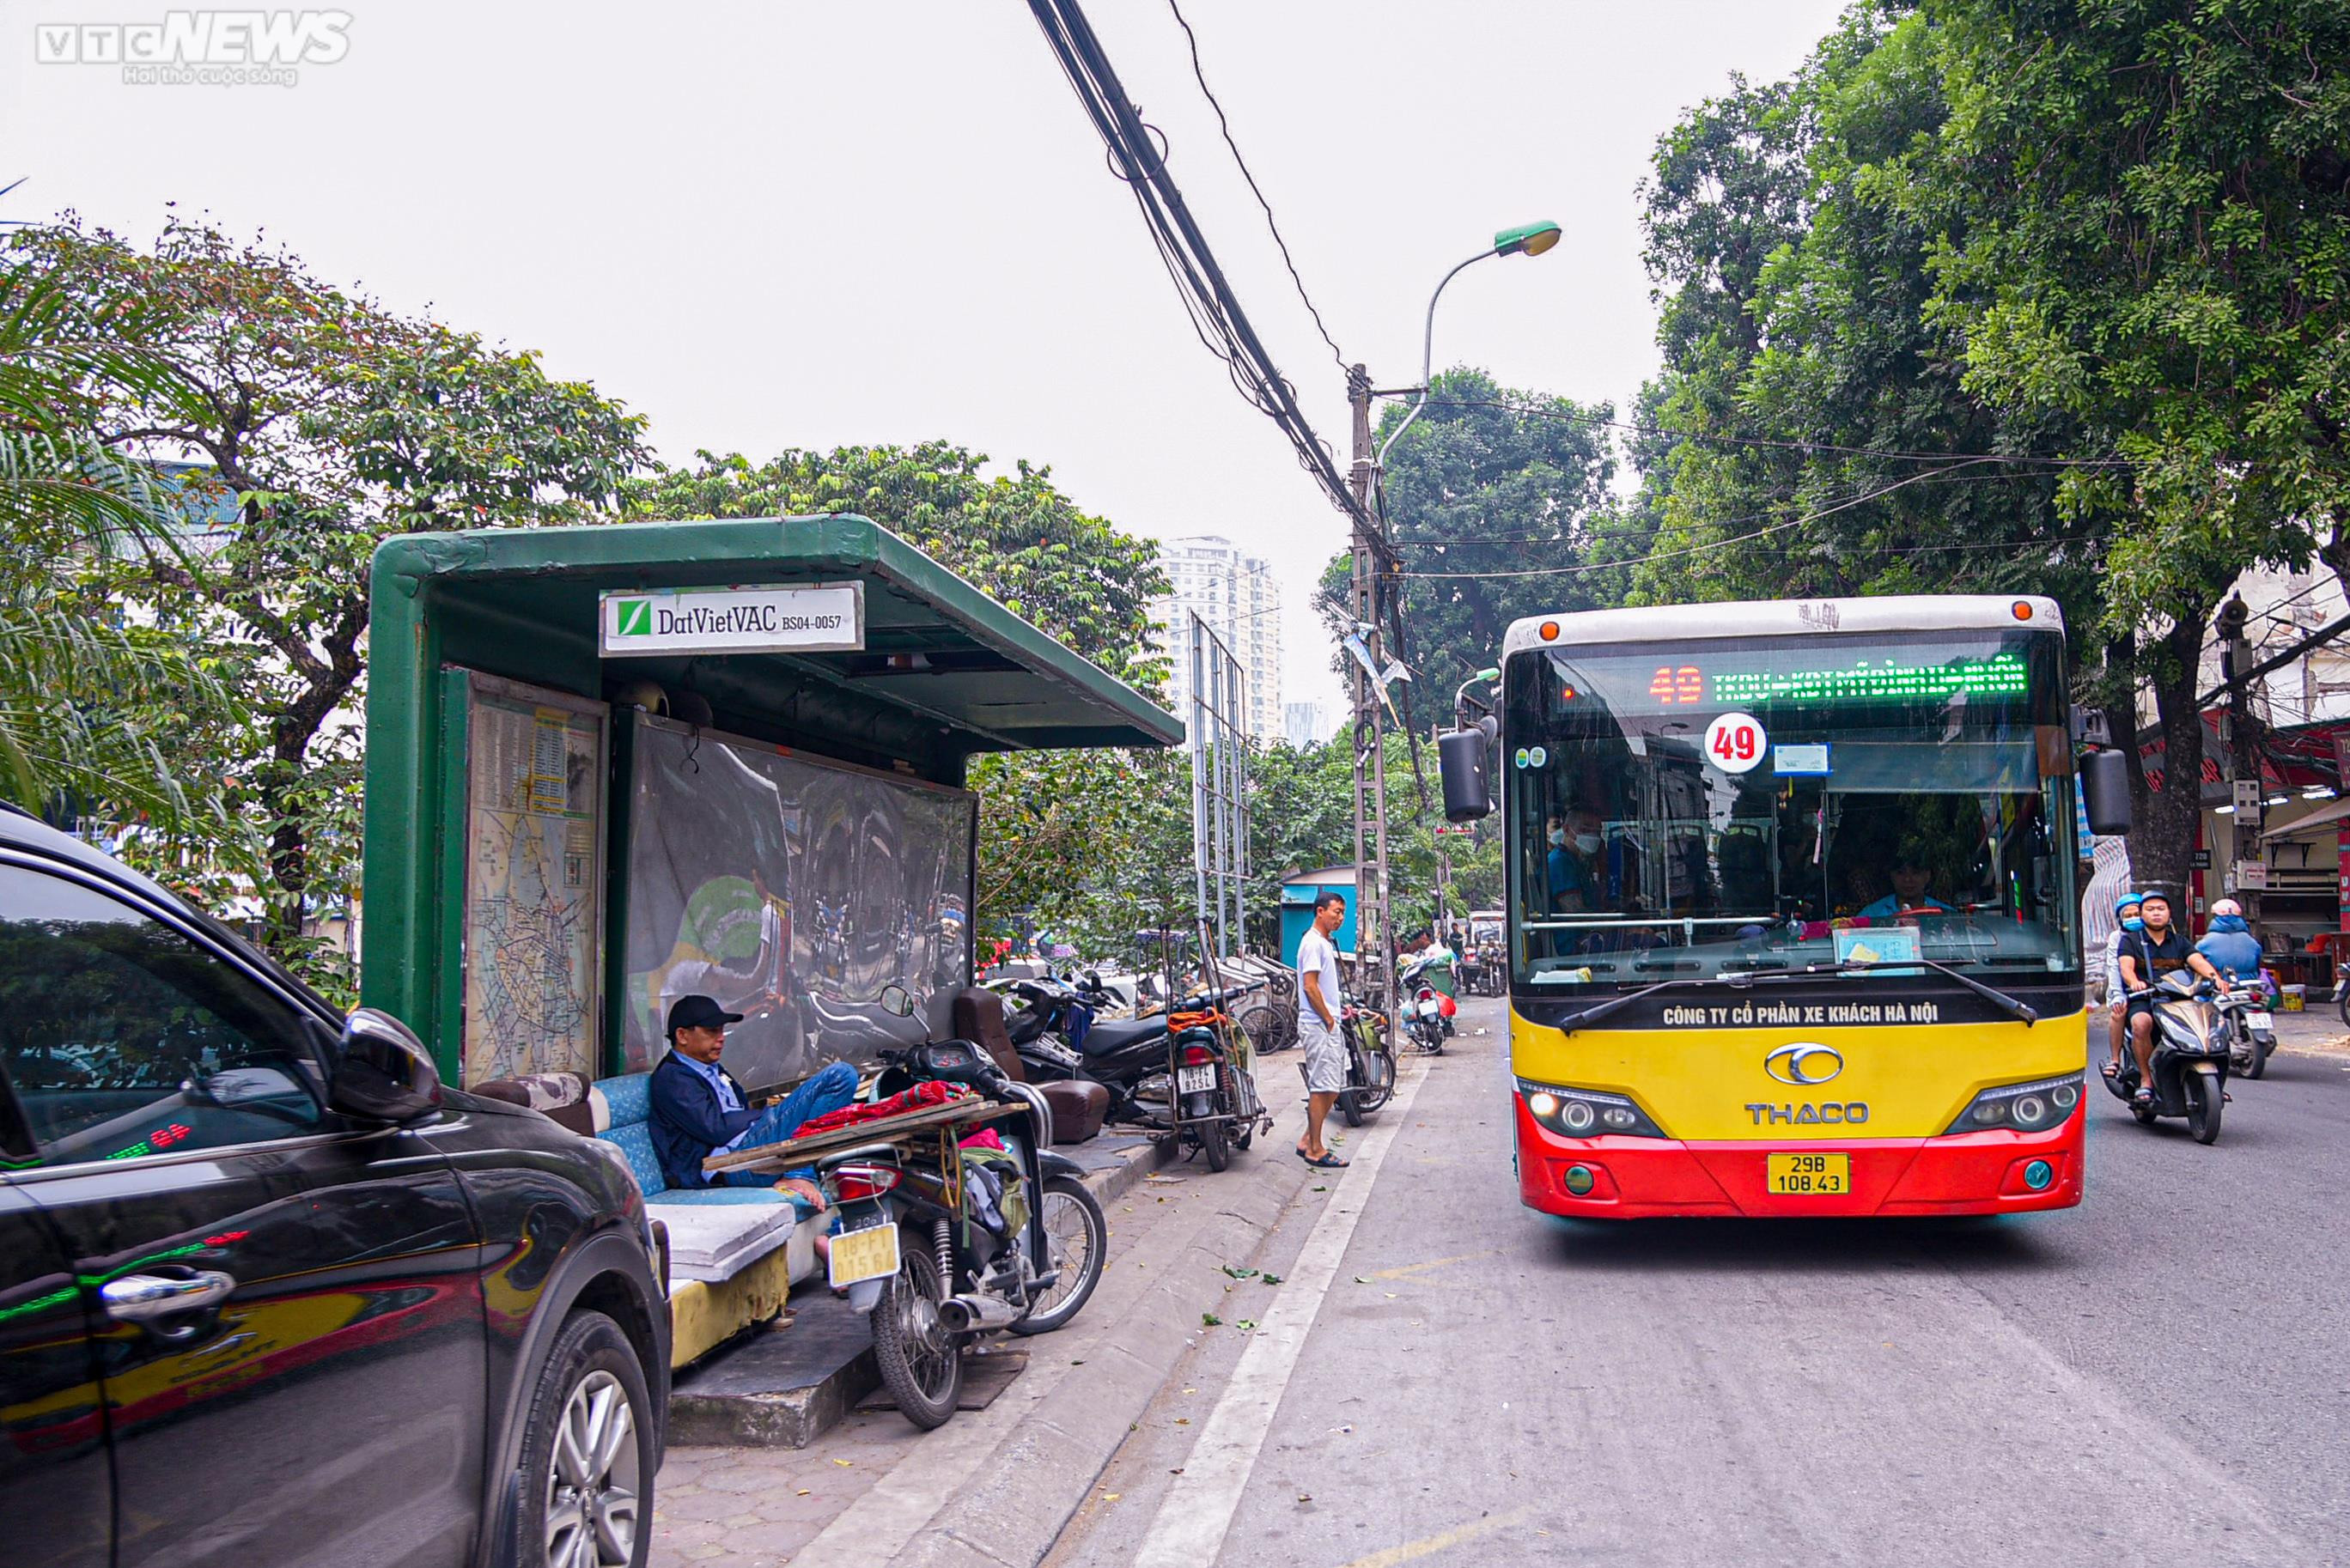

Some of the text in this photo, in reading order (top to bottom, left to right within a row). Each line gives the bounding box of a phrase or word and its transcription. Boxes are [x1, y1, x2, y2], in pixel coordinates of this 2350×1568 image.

[658, 605, 842, 635] DatVietVAC BS04-0057
[1713, 726, 1754, 760] 49
[1663, 1000, 1938, 1024] CÔNG TY CỔ PHẦN XE KHÁCH HÀ NỘI
[1744, 1103, 1870, 1124] THACO
[1791, 1157, 1825, 1172] 29B
[1778, 1175, 1840, 1191] 108.43
